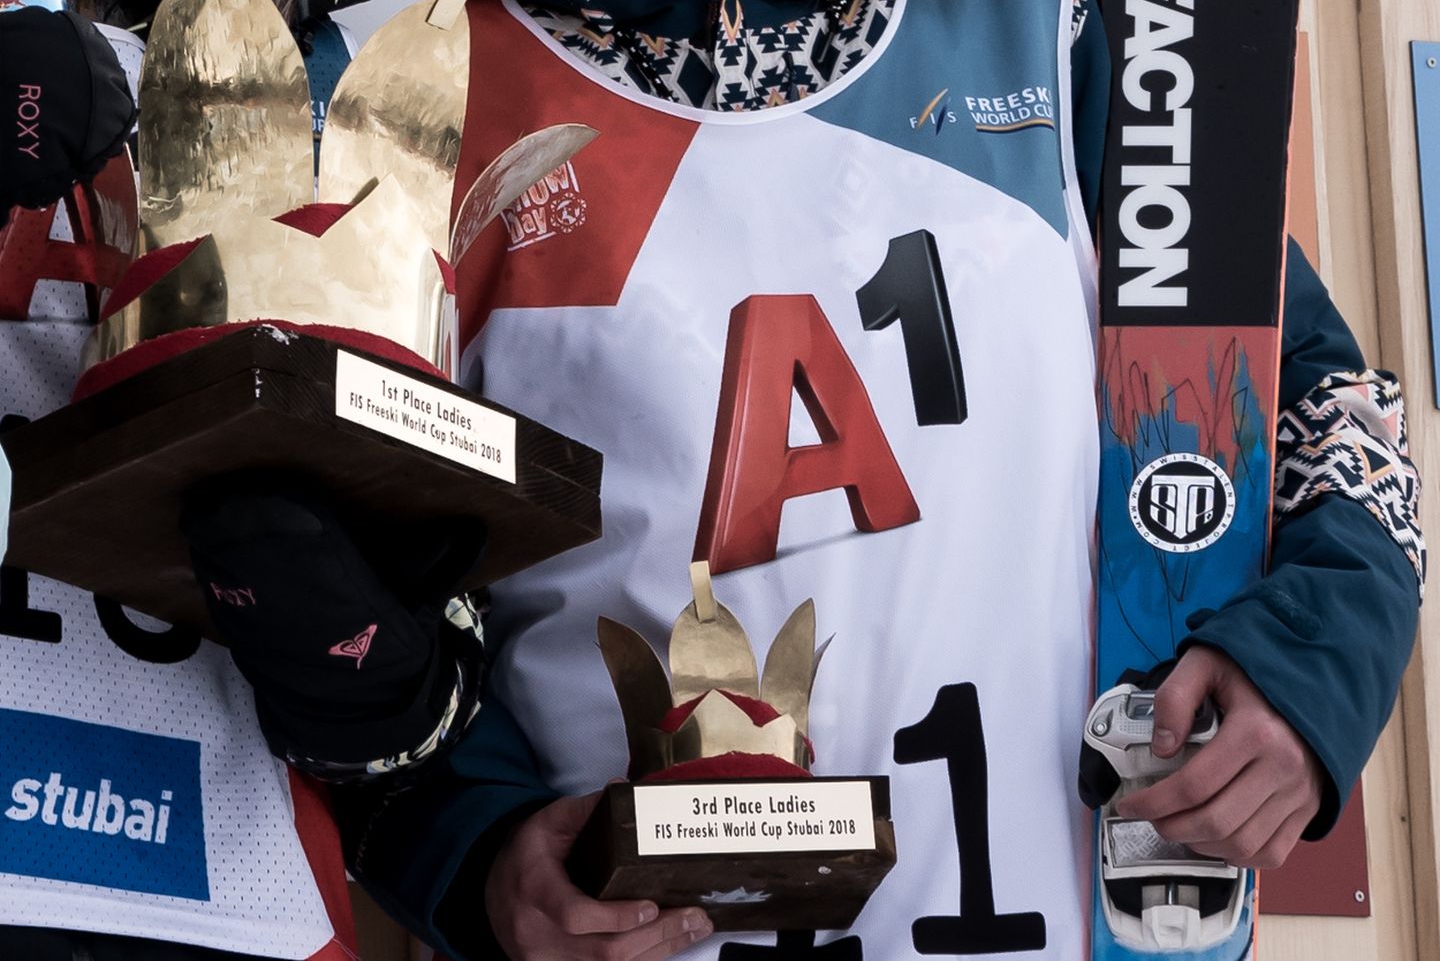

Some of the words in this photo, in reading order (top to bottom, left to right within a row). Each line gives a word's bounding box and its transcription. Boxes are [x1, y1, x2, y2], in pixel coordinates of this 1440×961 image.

[964, 86, 1053, 113] FREESK
[970, 106, 1032, 126] WORLD
[17, 84, 42, 159] ROXY
[910, 111, 957, 129] FIS
[381, 379, 399, 402] 1st
[403, 389, 432, 415] Place
[437, 401, 472, 431] Ladies
[691, 228, 968, 575] A1
[350, 392, 363, 410] FIS
[367, 399, 399, 423] Freeski
[401, 412, 427, 434] World
[430, 424, 446, 445] Cup
[450, 431, 478, 454] Stubai
[481, 444, 502, 464] 2018
[5, 772, 173, 844] stubai
[692, 796, 718, 816] 3rd
[724, 796, 762, 815] Place
[769, 795, 816, 814] Ladies
[655, 824, 672, 839] FIS
[677, 822, 719, 838] Freeski
[723, 820, 756, 838] World
[761, 821, 782, 840] Cup
[787, 819, 824, 836] Stubai
[828, 819, 856, 835] 2018
